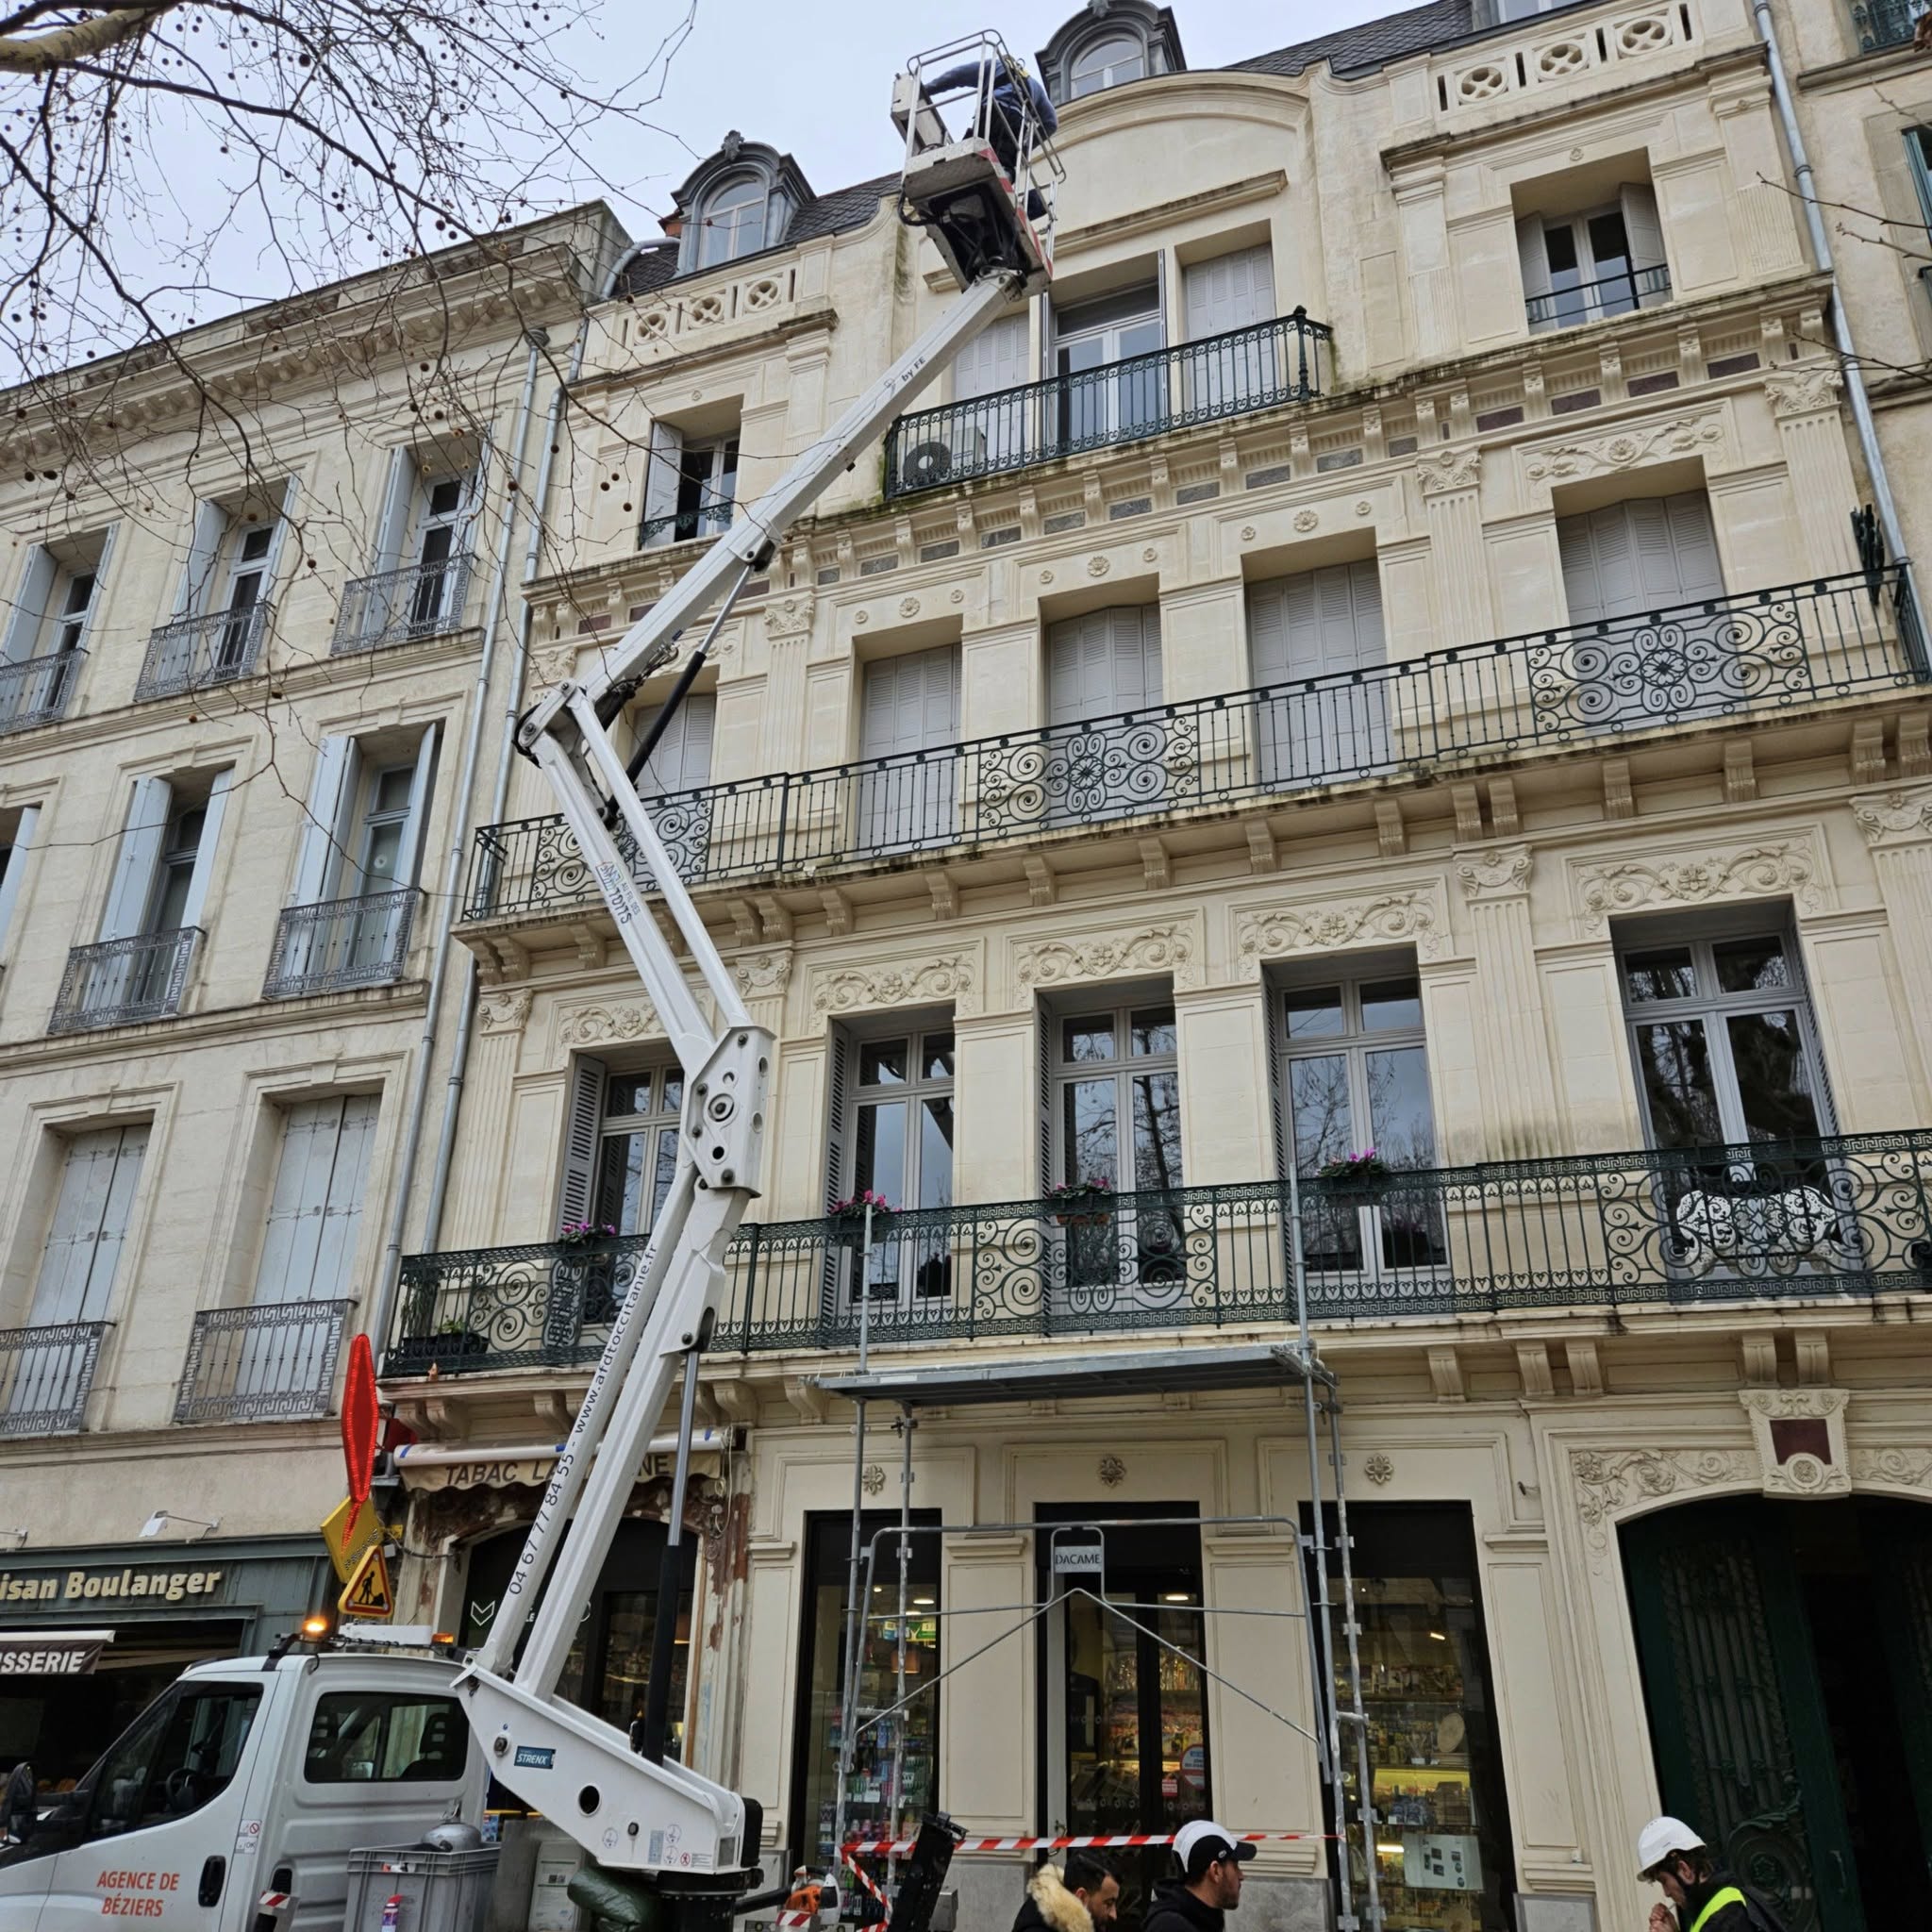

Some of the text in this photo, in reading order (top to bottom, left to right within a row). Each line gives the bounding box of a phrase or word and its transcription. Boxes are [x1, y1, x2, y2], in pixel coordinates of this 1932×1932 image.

[901, 369, 914, 382] by
[509, 1571, 527, 1594] 04
[522, 1540, 539, 1565] 67
[533, 1509, 550, 1534] 77
[544, 1482, 563, 1506] 84
[557, 1453, 575, 1477] 55
[575, 1242, 658, 1434] www.afdtoccitanie.fr
[444, 1462, 519, 1486] TABAC
[1055, 1554, 1101, 1565] DACAME
[64, 1569, 221, 1601] Boulanger
[517, 1754, 547, 1765] STRENX
[97, 1871, 180, 1891] AGENCE DE
[101, 1891, 164, 1917] BÉZIERS
